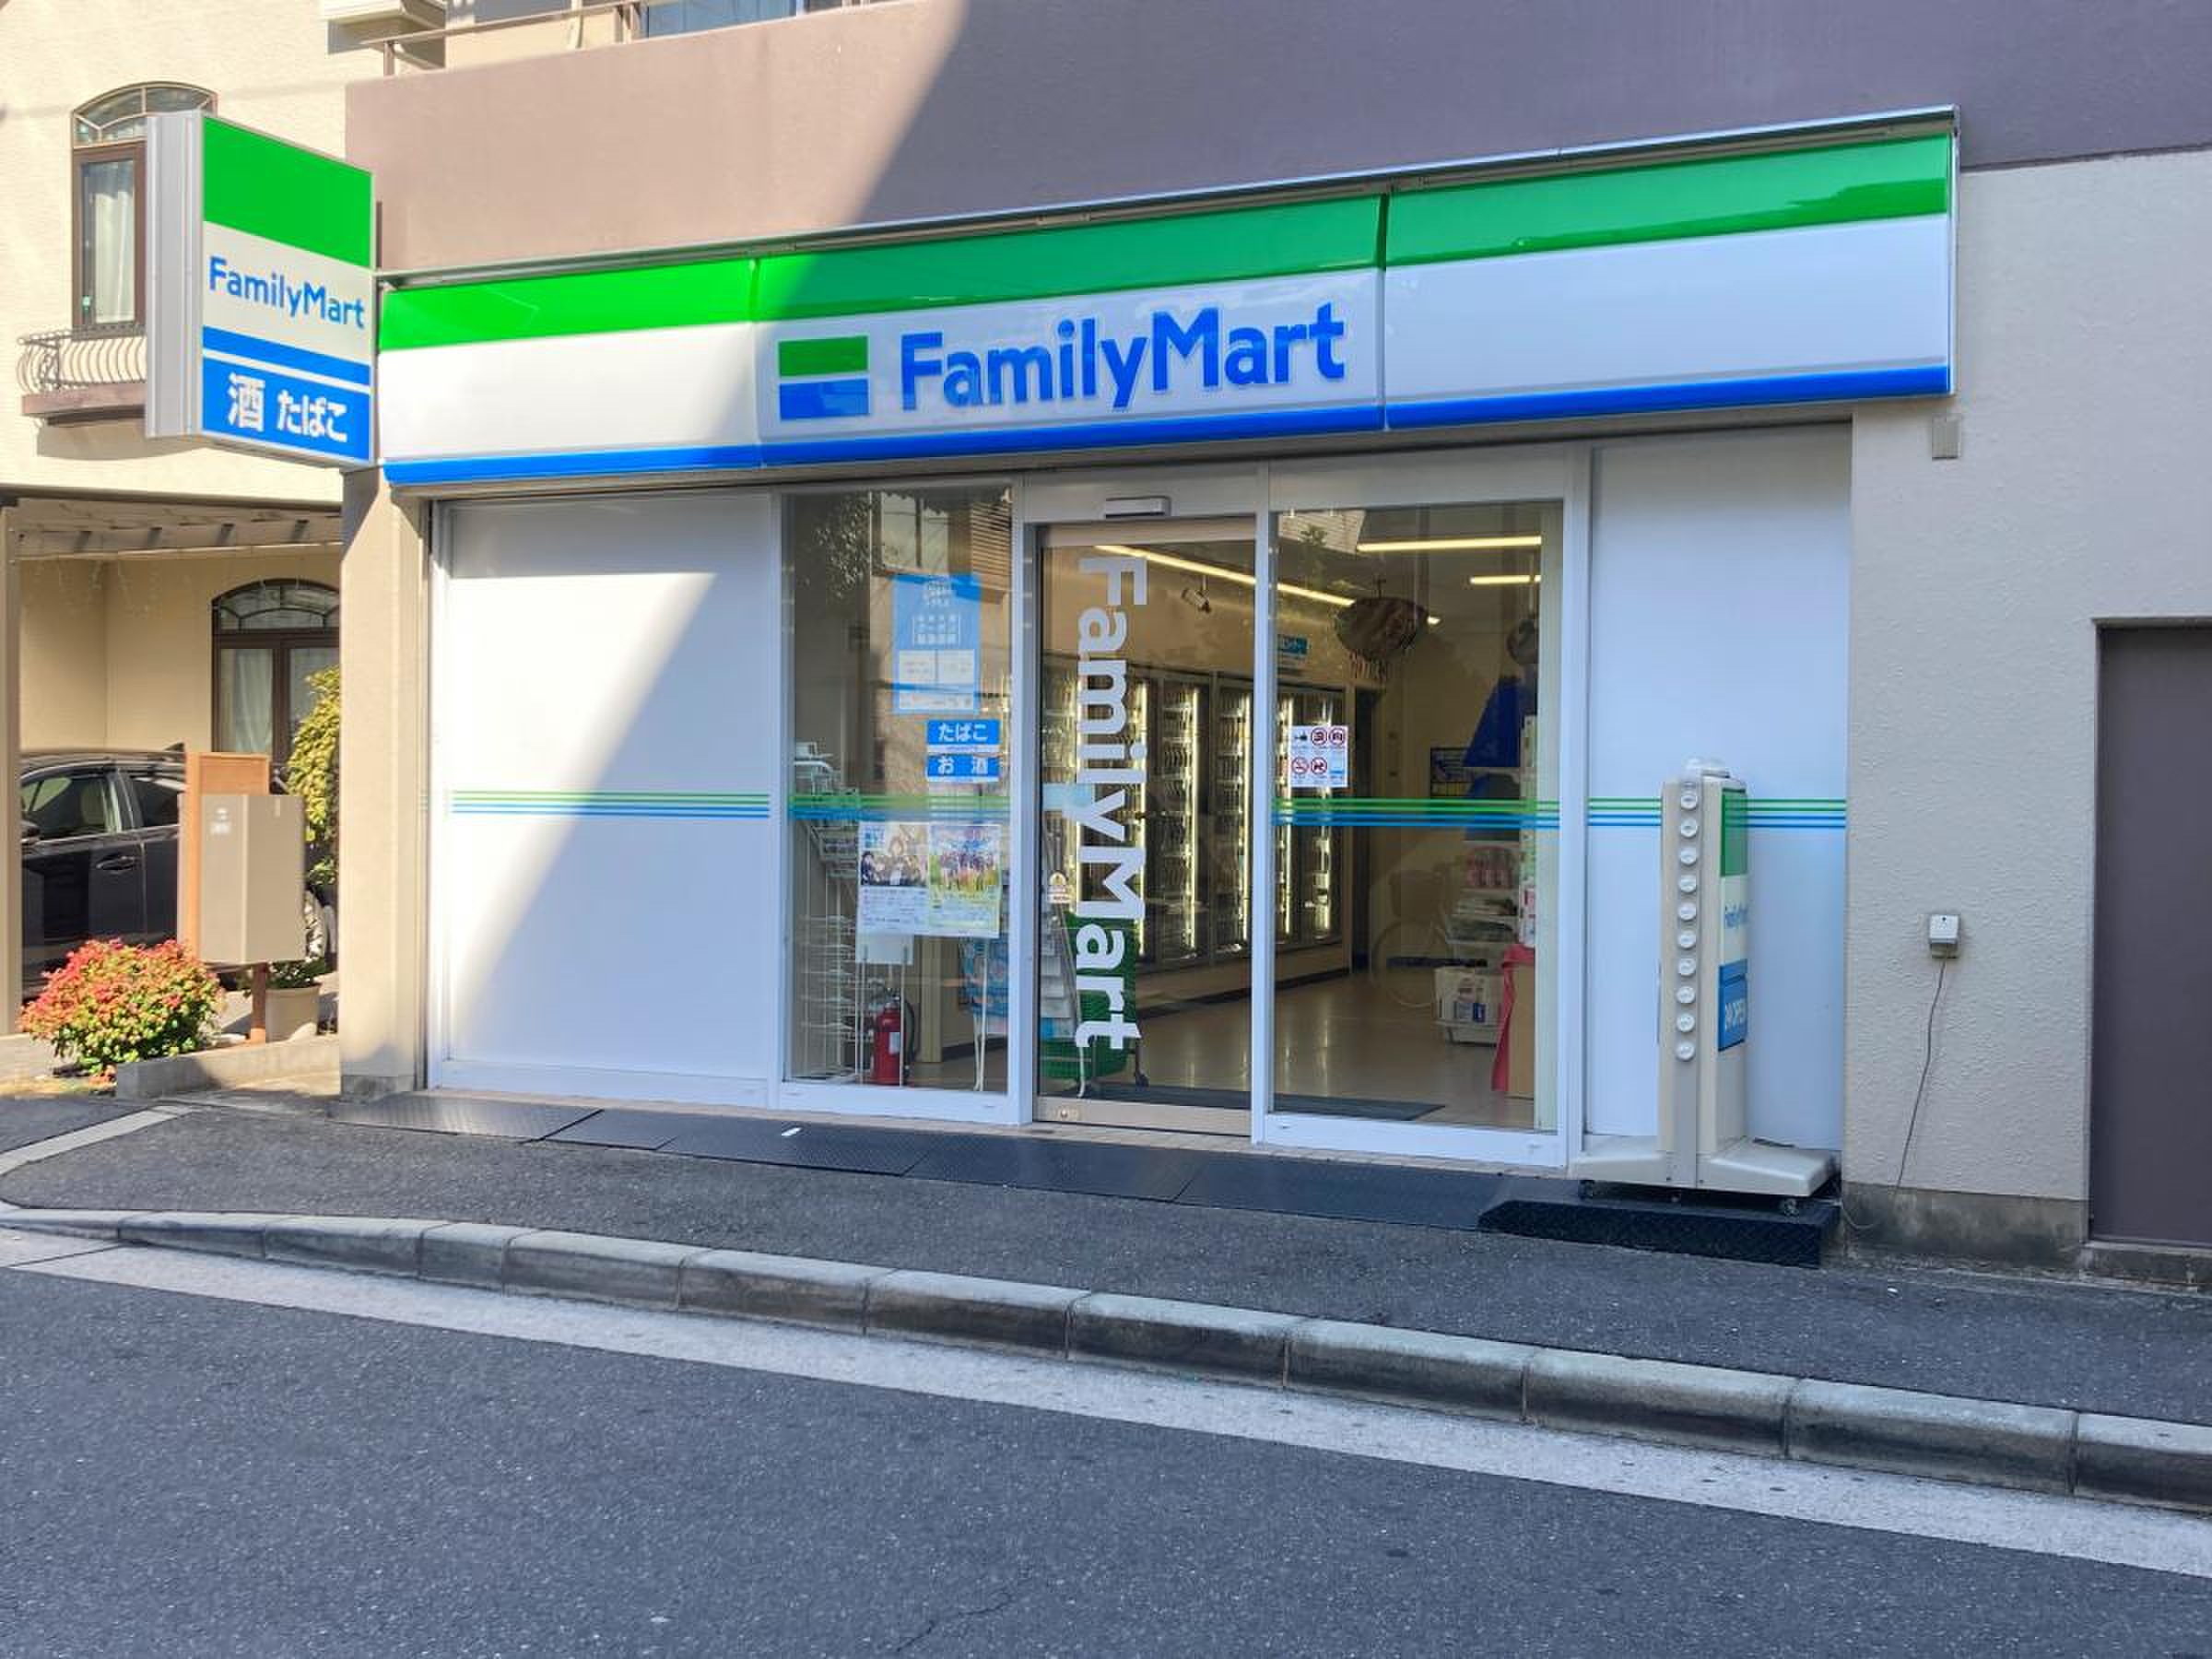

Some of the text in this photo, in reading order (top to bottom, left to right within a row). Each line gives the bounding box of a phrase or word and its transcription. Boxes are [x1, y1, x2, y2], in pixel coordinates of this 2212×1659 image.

[209, 256, 366, 329] FamilyMart
[900, 300, 1346, 412] FamilyMart
[228, 371, 348, 442] 酒 たばこ
[938, 723, 989, 742] たばこ
[1064, 557, 1148, 1050] FamilyMart
